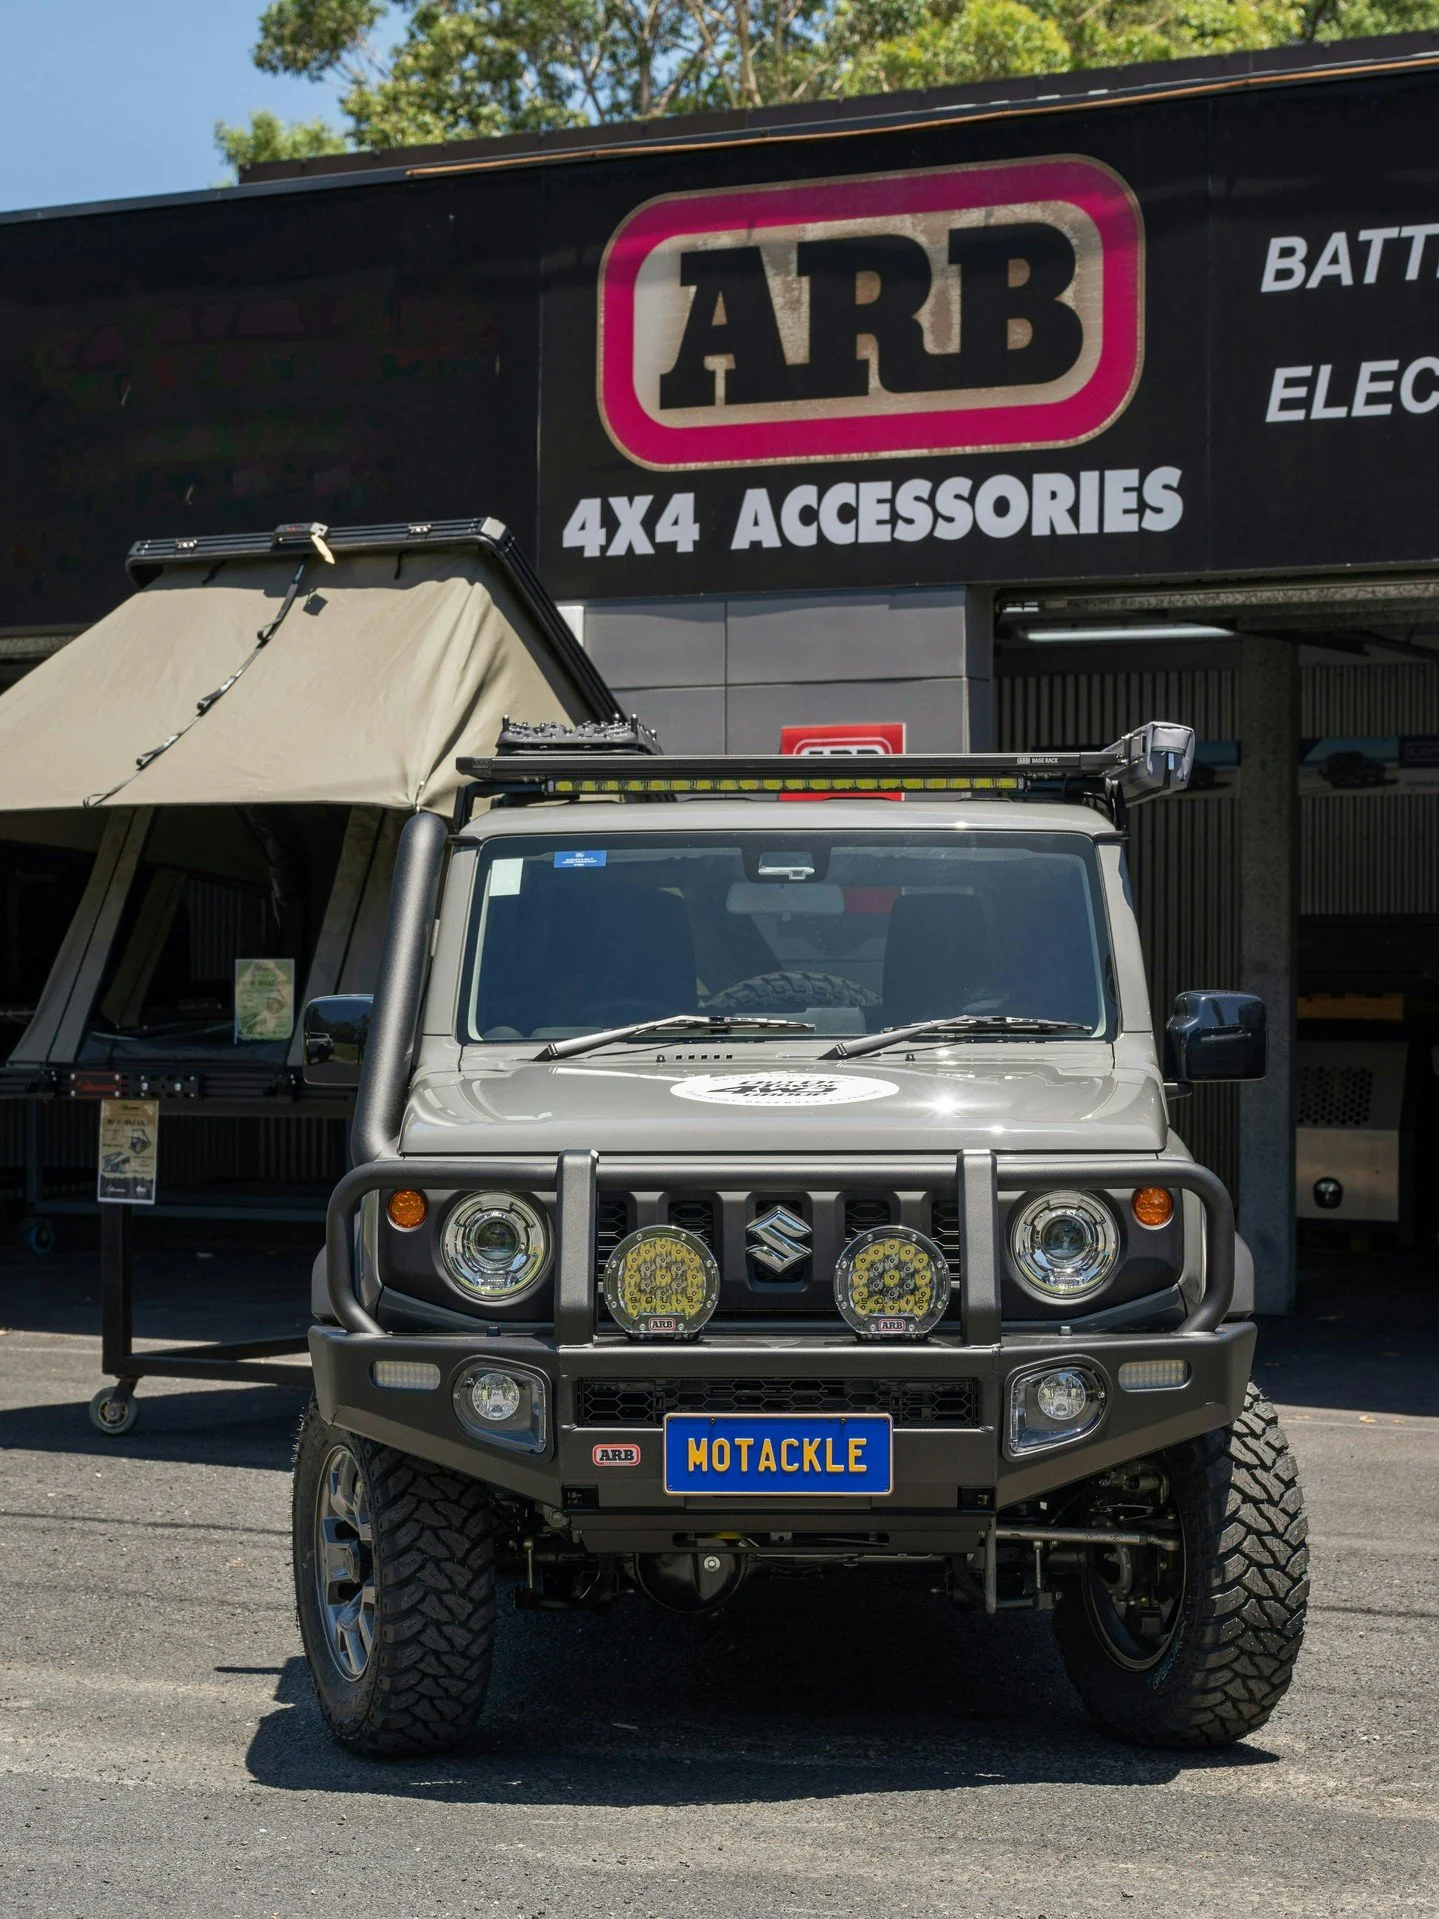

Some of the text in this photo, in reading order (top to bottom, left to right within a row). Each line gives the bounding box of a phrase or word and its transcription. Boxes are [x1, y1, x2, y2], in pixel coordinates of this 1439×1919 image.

[1261, 223, 1439, 293] BATT
[659, 222, 1084, 410] ARB
[562, 466, 1185, 558] 4X4 ACCESSORIES
[630, 1296, 694, 1304] SOLIS
[860, 1296, 925, 1304] SOLIS
[652, 1320, 673, 1328] ARB
[882, 1321, 903, 1329] ARB
[599, 1449, 635, 1461] ARB
[687, 1438, 867, 1472] MOTACKLE
